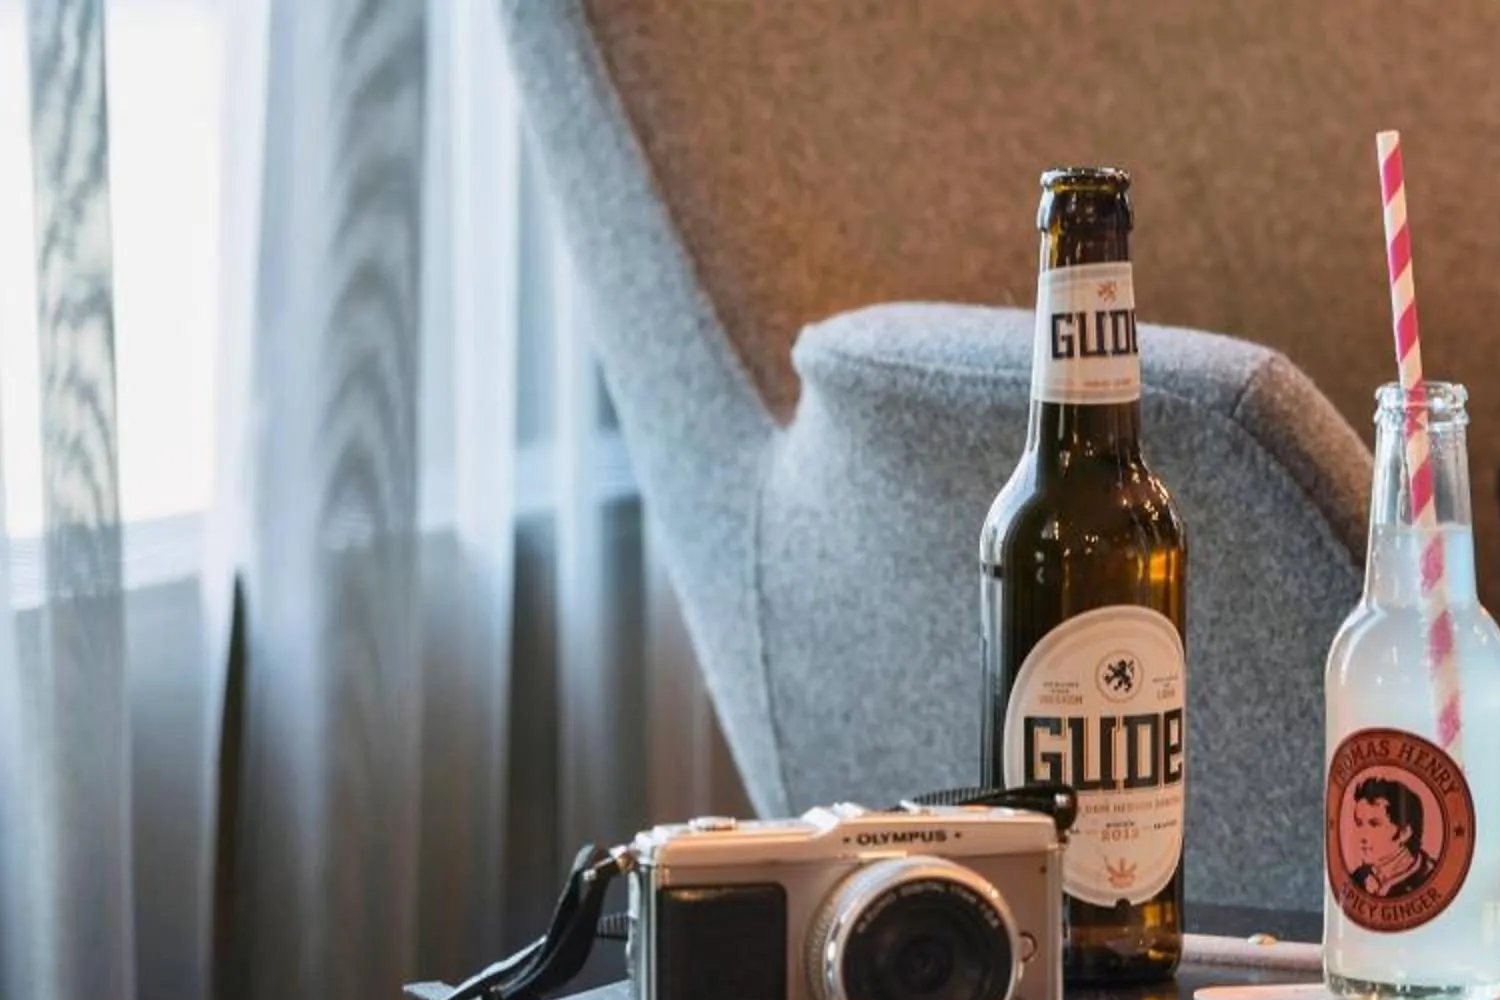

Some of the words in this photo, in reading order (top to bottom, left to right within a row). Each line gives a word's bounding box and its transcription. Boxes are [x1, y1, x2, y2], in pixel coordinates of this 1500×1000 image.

[1397, 744, 1458, 794] HENRY
[856, 829, 948, 846] OLYMPUS
[1381, 888, 1438, 921] GINGER
